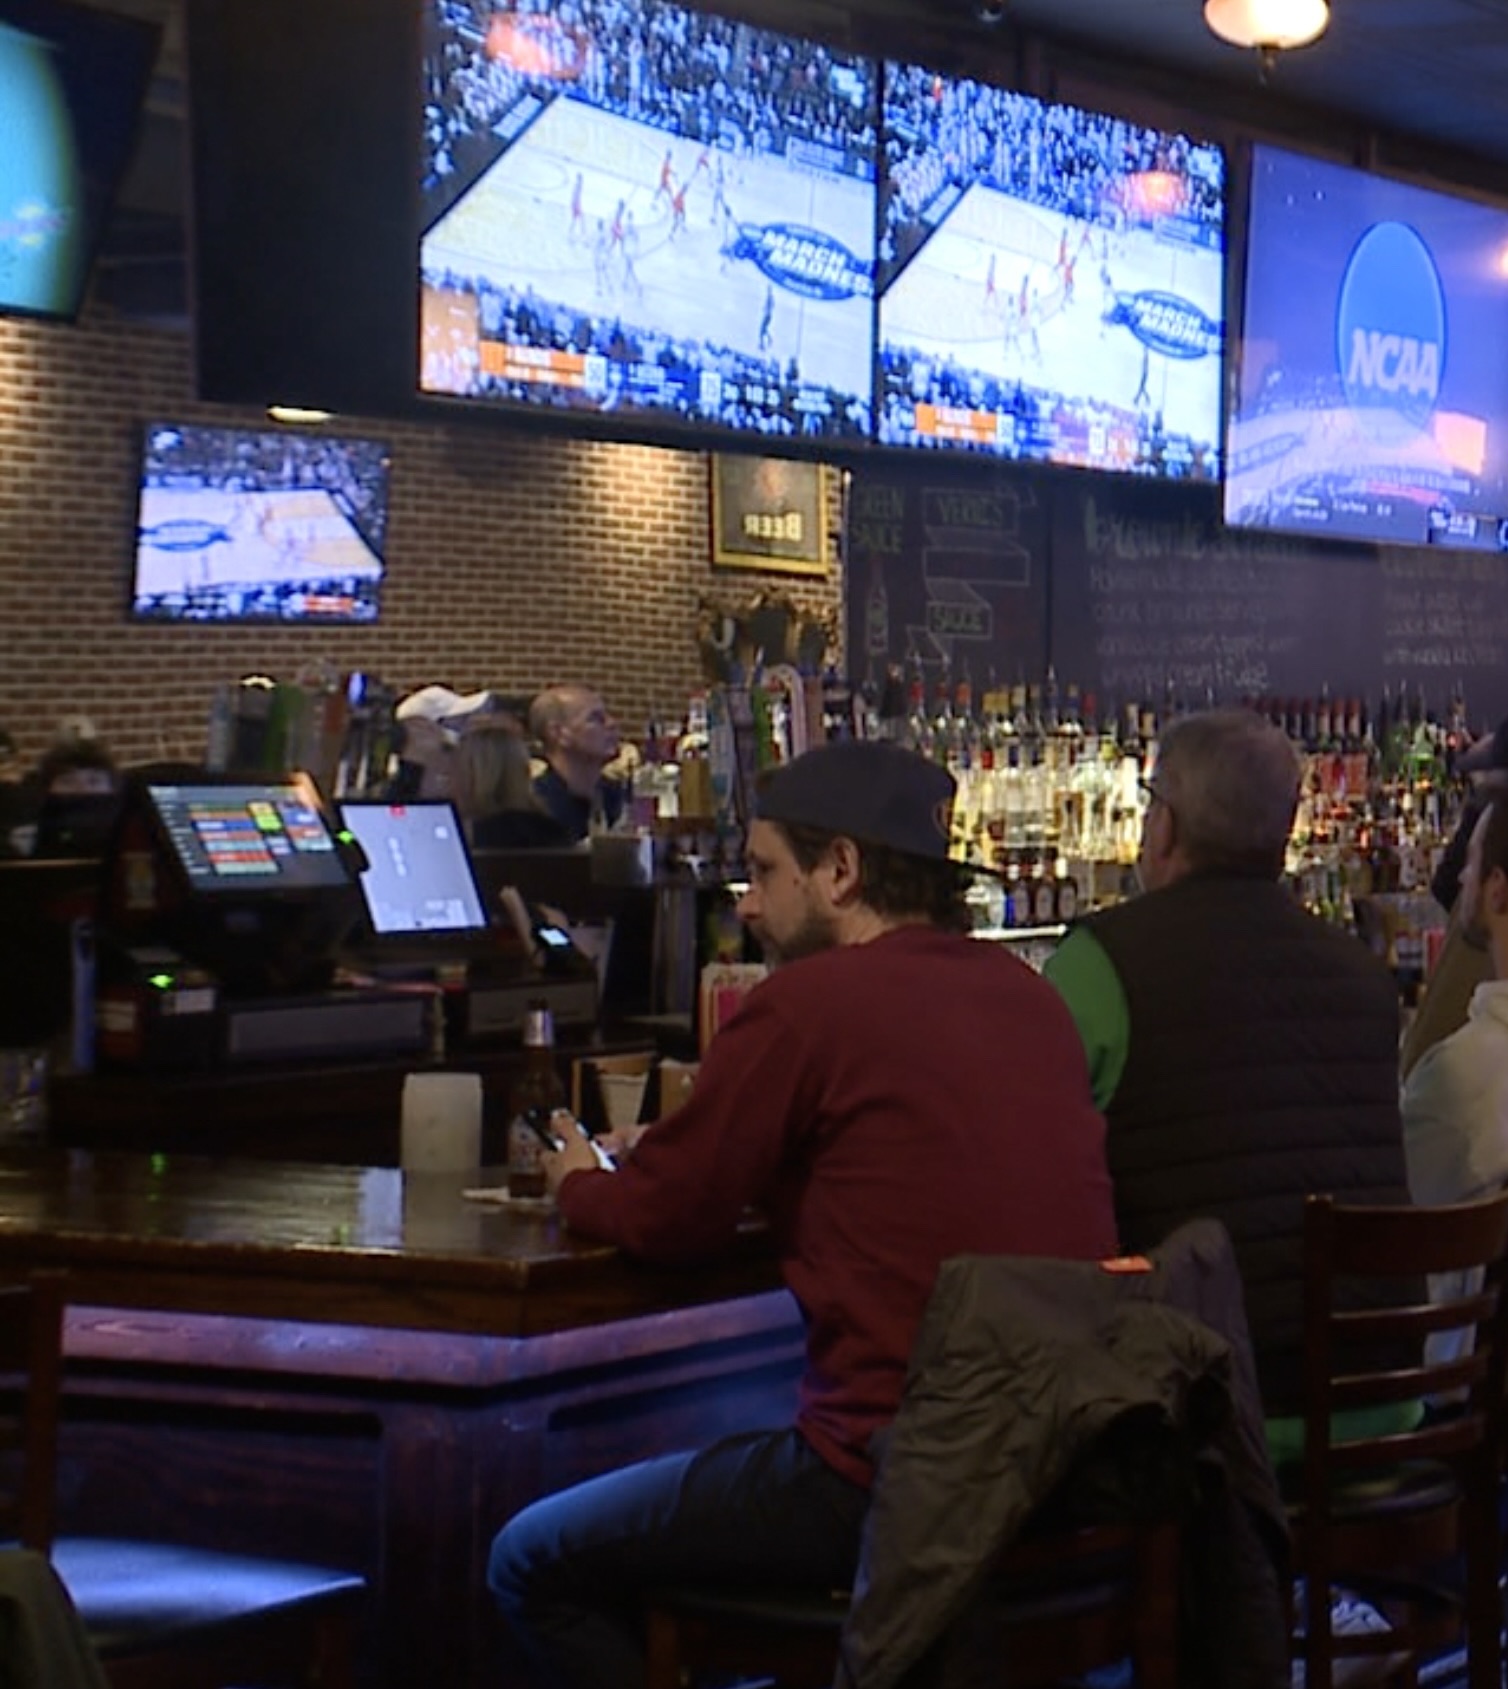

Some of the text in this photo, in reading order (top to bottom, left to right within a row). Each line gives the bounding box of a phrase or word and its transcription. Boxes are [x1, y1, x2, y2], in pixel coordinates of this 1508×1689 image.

[761, 229, 847, 269] MARCH
[768, 249, 875, 296] MADNES
[1134, 298, 1200, 332] MARCH
[1347, 326, 1438, 399] NCAA
